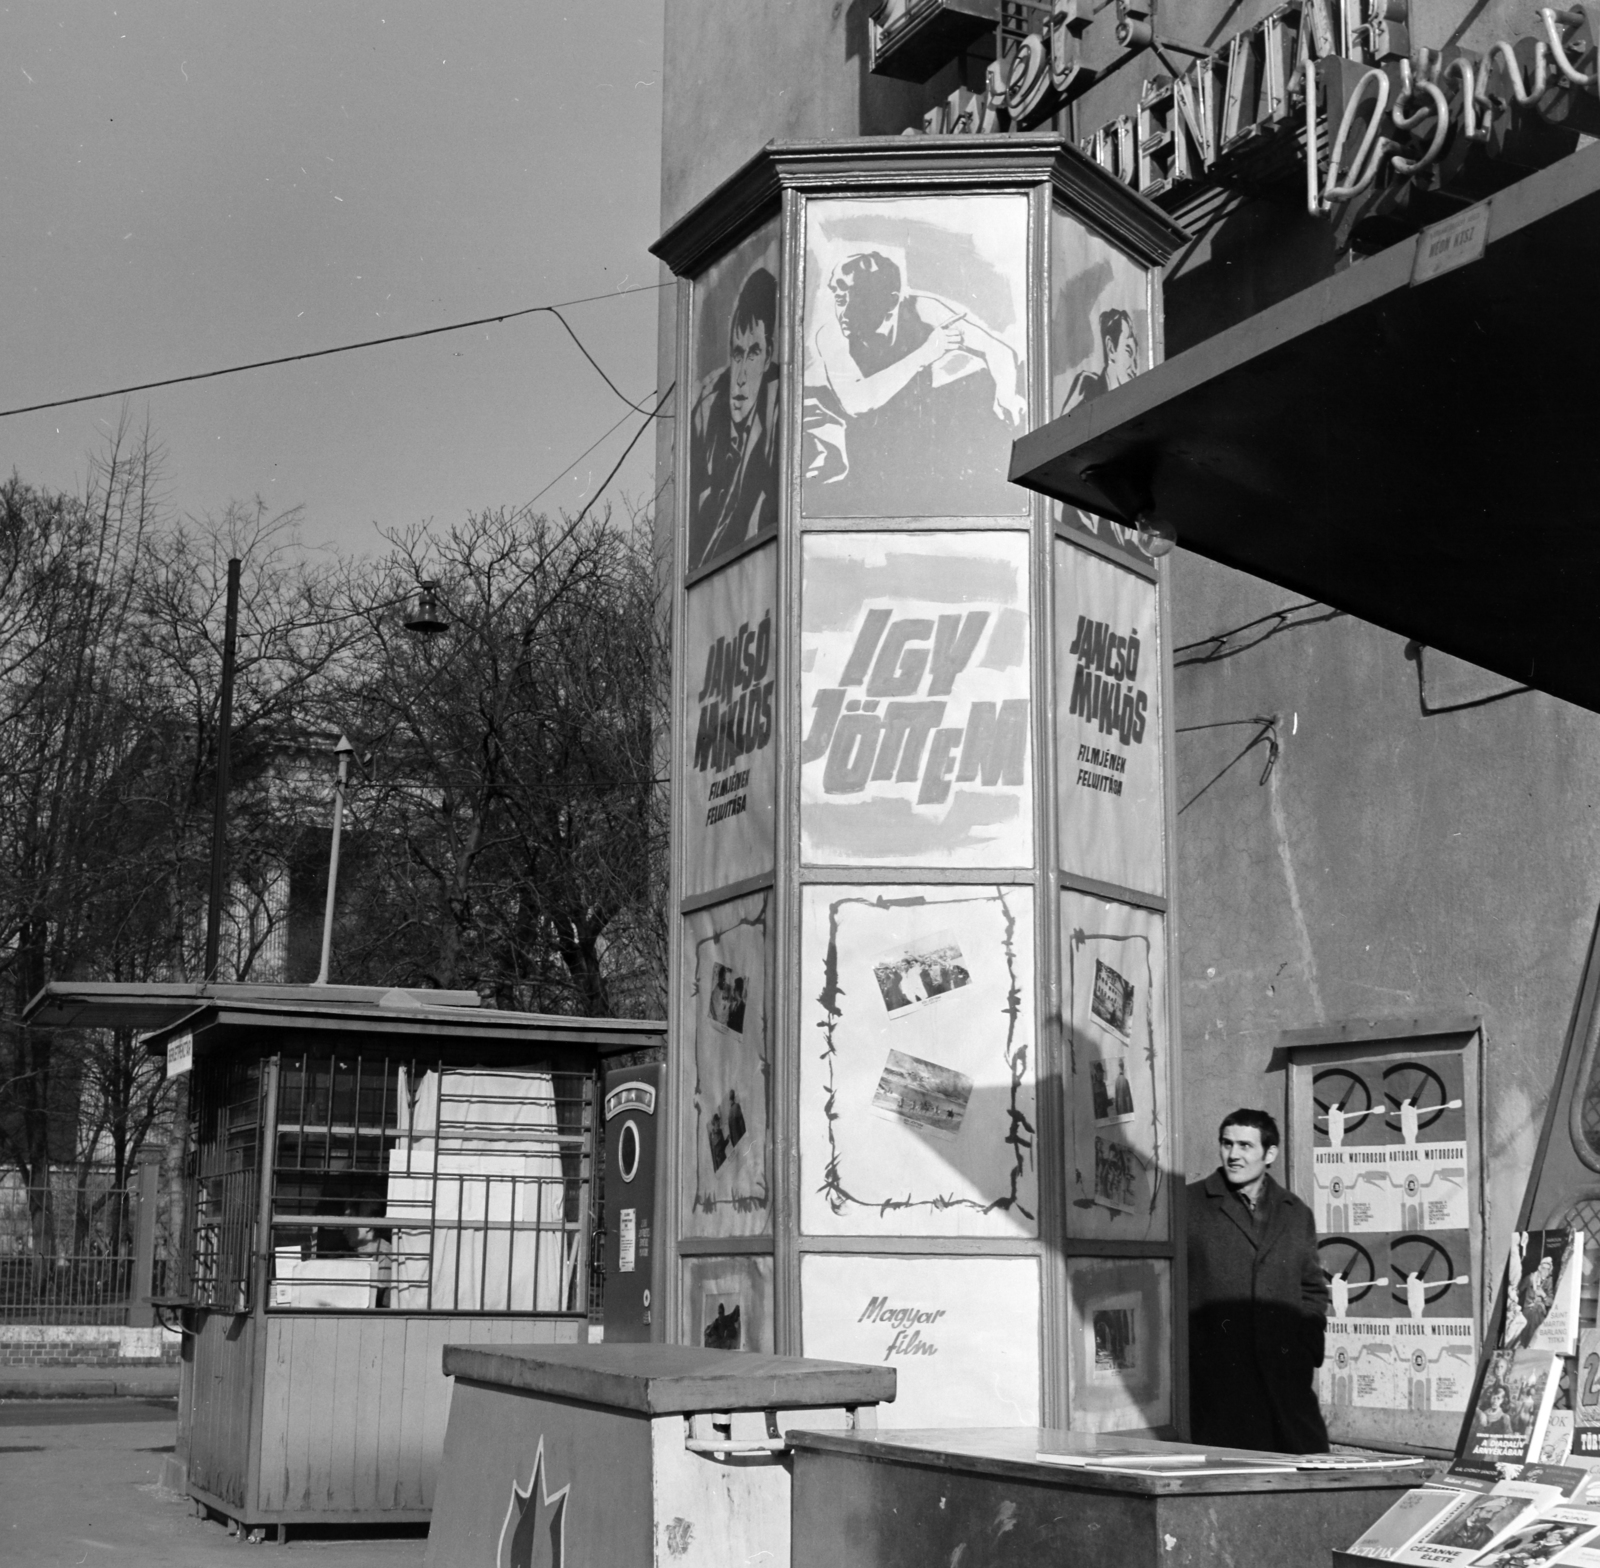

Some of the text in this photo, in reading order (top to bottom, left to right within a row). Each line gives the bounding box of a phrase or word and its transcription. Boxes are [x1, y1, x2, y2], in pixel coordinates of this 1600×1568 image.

[1453, 226, 1475, 248] KTSZ
[698, 608, 771, 704] JANCSÓ
[838, 608, 991, 697] IGY
[1069, 615, 1140, 682] JANCSÓ
[1069, 663, 1148, 746] MIKLÓS
[693, 680, 775, 774] MIKLÓS
[801, 688, 1030, 806] JÖTTEM
[1077, 743, 1127, 774] FILMJÉNEK
[708, 768, 750, 801] FILMJÉNEK
[1349, 1152, 1387, 1163] MOTOROSOK
[1425, 1148, 1464, 1160] MOTOROSOK
[857, 1296, 946, 1329] Magyar
[1550, 1311, 1568, 1319] SAINT
[1353, 1324, 1390, 1335] MOTOROSOK
[1431, 1325, 1471, 1336] MOTOROSOK
[1539, 1328, 1567, 1336] BARLANG
[883, 1329, 938, 1361] film
[1472, 1445, 1524, 1457] ÁRNYÉKÁBAN
[1410, 1545, 1462, 1557] CÉZANNE
[1420, 1553, 1455, 1563] ÉLETE
